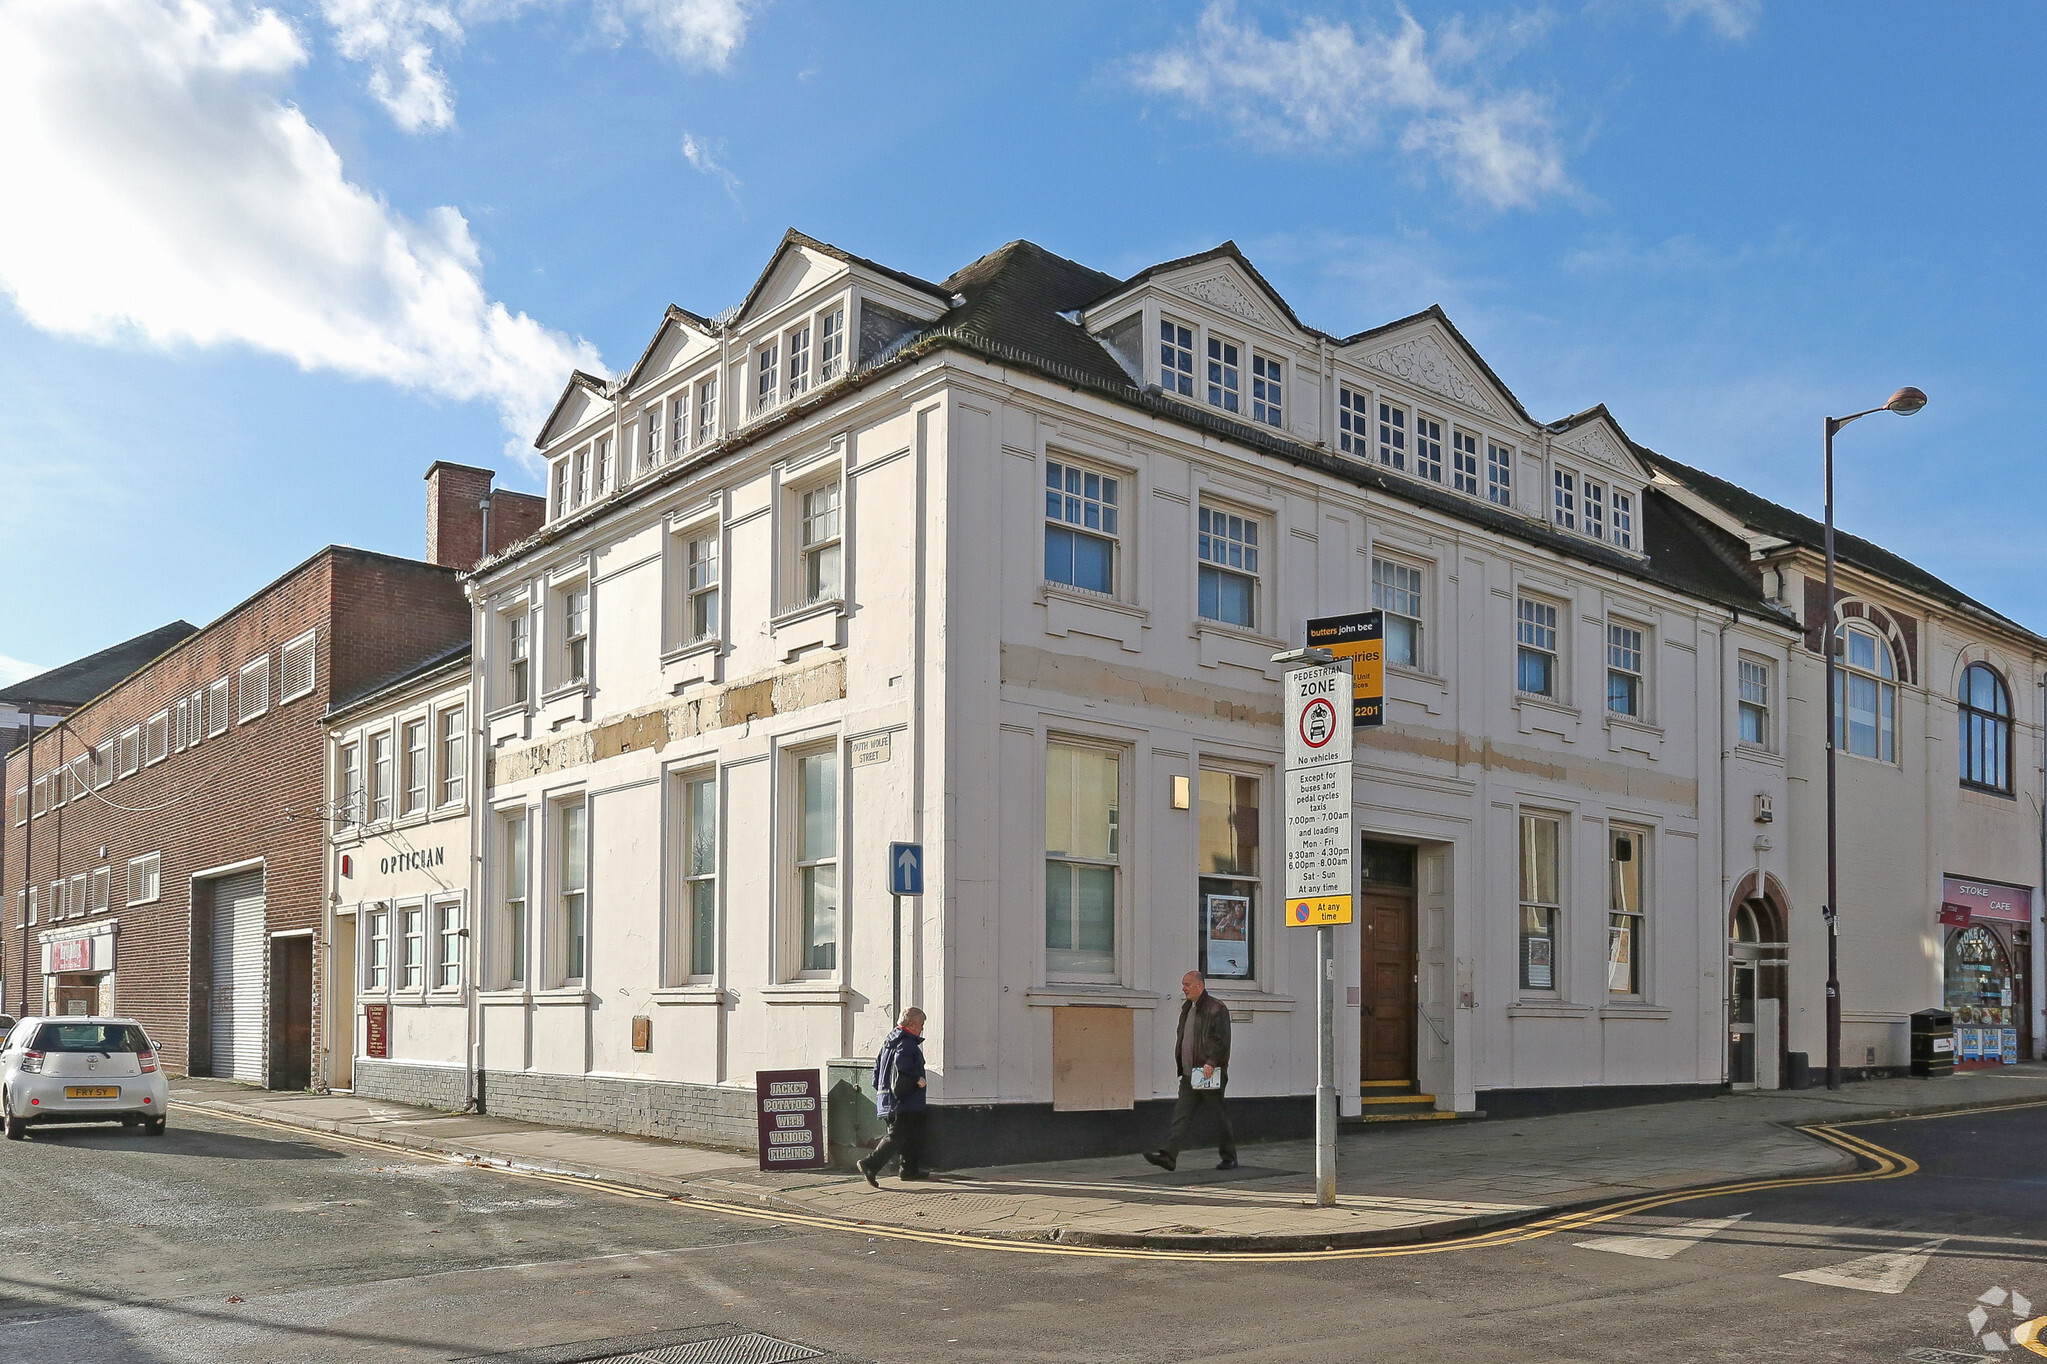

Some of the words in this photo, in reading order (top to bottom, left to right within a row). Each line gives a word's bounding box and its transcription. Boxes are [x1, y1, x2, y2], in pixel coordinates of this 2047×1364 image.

[1311, 628, 1337, 637] butters
[1338, 625, 1355, 635] john
[1358, 623, 1373, 631] bee
[1293, 665, 1343, 682] PEDESTRIAN
[1301, 679, 1335, 697] ZONE
[1355, 705, 1379, 717] 2201
[870, 737, 889, 749] WOLFE
[859, 751, 879, 763] STREET
[1298, 756, 1308, 765] No
[1309, 753, 1339, 763] vehicles
[1300, 773, 1324, 783] Except
[1326, 771, 1336, 779] for
[1301, 784, 1321, 793] buses
[1297, 795, 1316, 804] pedal
[1318, 792, 1339, 802] cycles
[1310, 803, 1326, 812] taxis
[1289, 816, 1315, 825] 7.00pm
[1322, 812, 1349, 821] 7.00am
[1299, 829, 1311, 837] and
[1313, 826, 1339, 836] loading
[1303, 840, 1317, 848] Mon
[1324, 838, 1334, 846] Fri
[1289, 851, 1314, 859] 9.30am
[1321, 847, 1349, 857] 4.30pm
[381, 846, 444, 875] OPTICIAN
[1289, 861, 1315, 870] 6.00pm
[1303, 872, 1315, 881] Sat
[1322, 871, 1336, 879] Sun
[1299, 885, 1307, 893] At
[1309, 885, 1321, 894] any
[1323, 883, 1338, 891] time
[1960, 886, 1989, 897] STOKE
[1317, 903, 1326, 911] At
[1328, 903, 1340, 912] any
[1990, 901, 2011, 911] CAFE
[1322, 912, 1337, 920] time
[1956, 927, 1978, 955] STOKE
[1979, 929, 1997, 960] CAFE
[75, 1088, 95, 1096] FRY
[771, 1082, 806, 1094] JACKET
[765, 1098, 814, 1111] POTATOES
[777, 1115, 804, 1126] WITH
[770, 1131, 811, 1143] VARIOUS
[769, 1148, 814, 1160] FILLINGS
